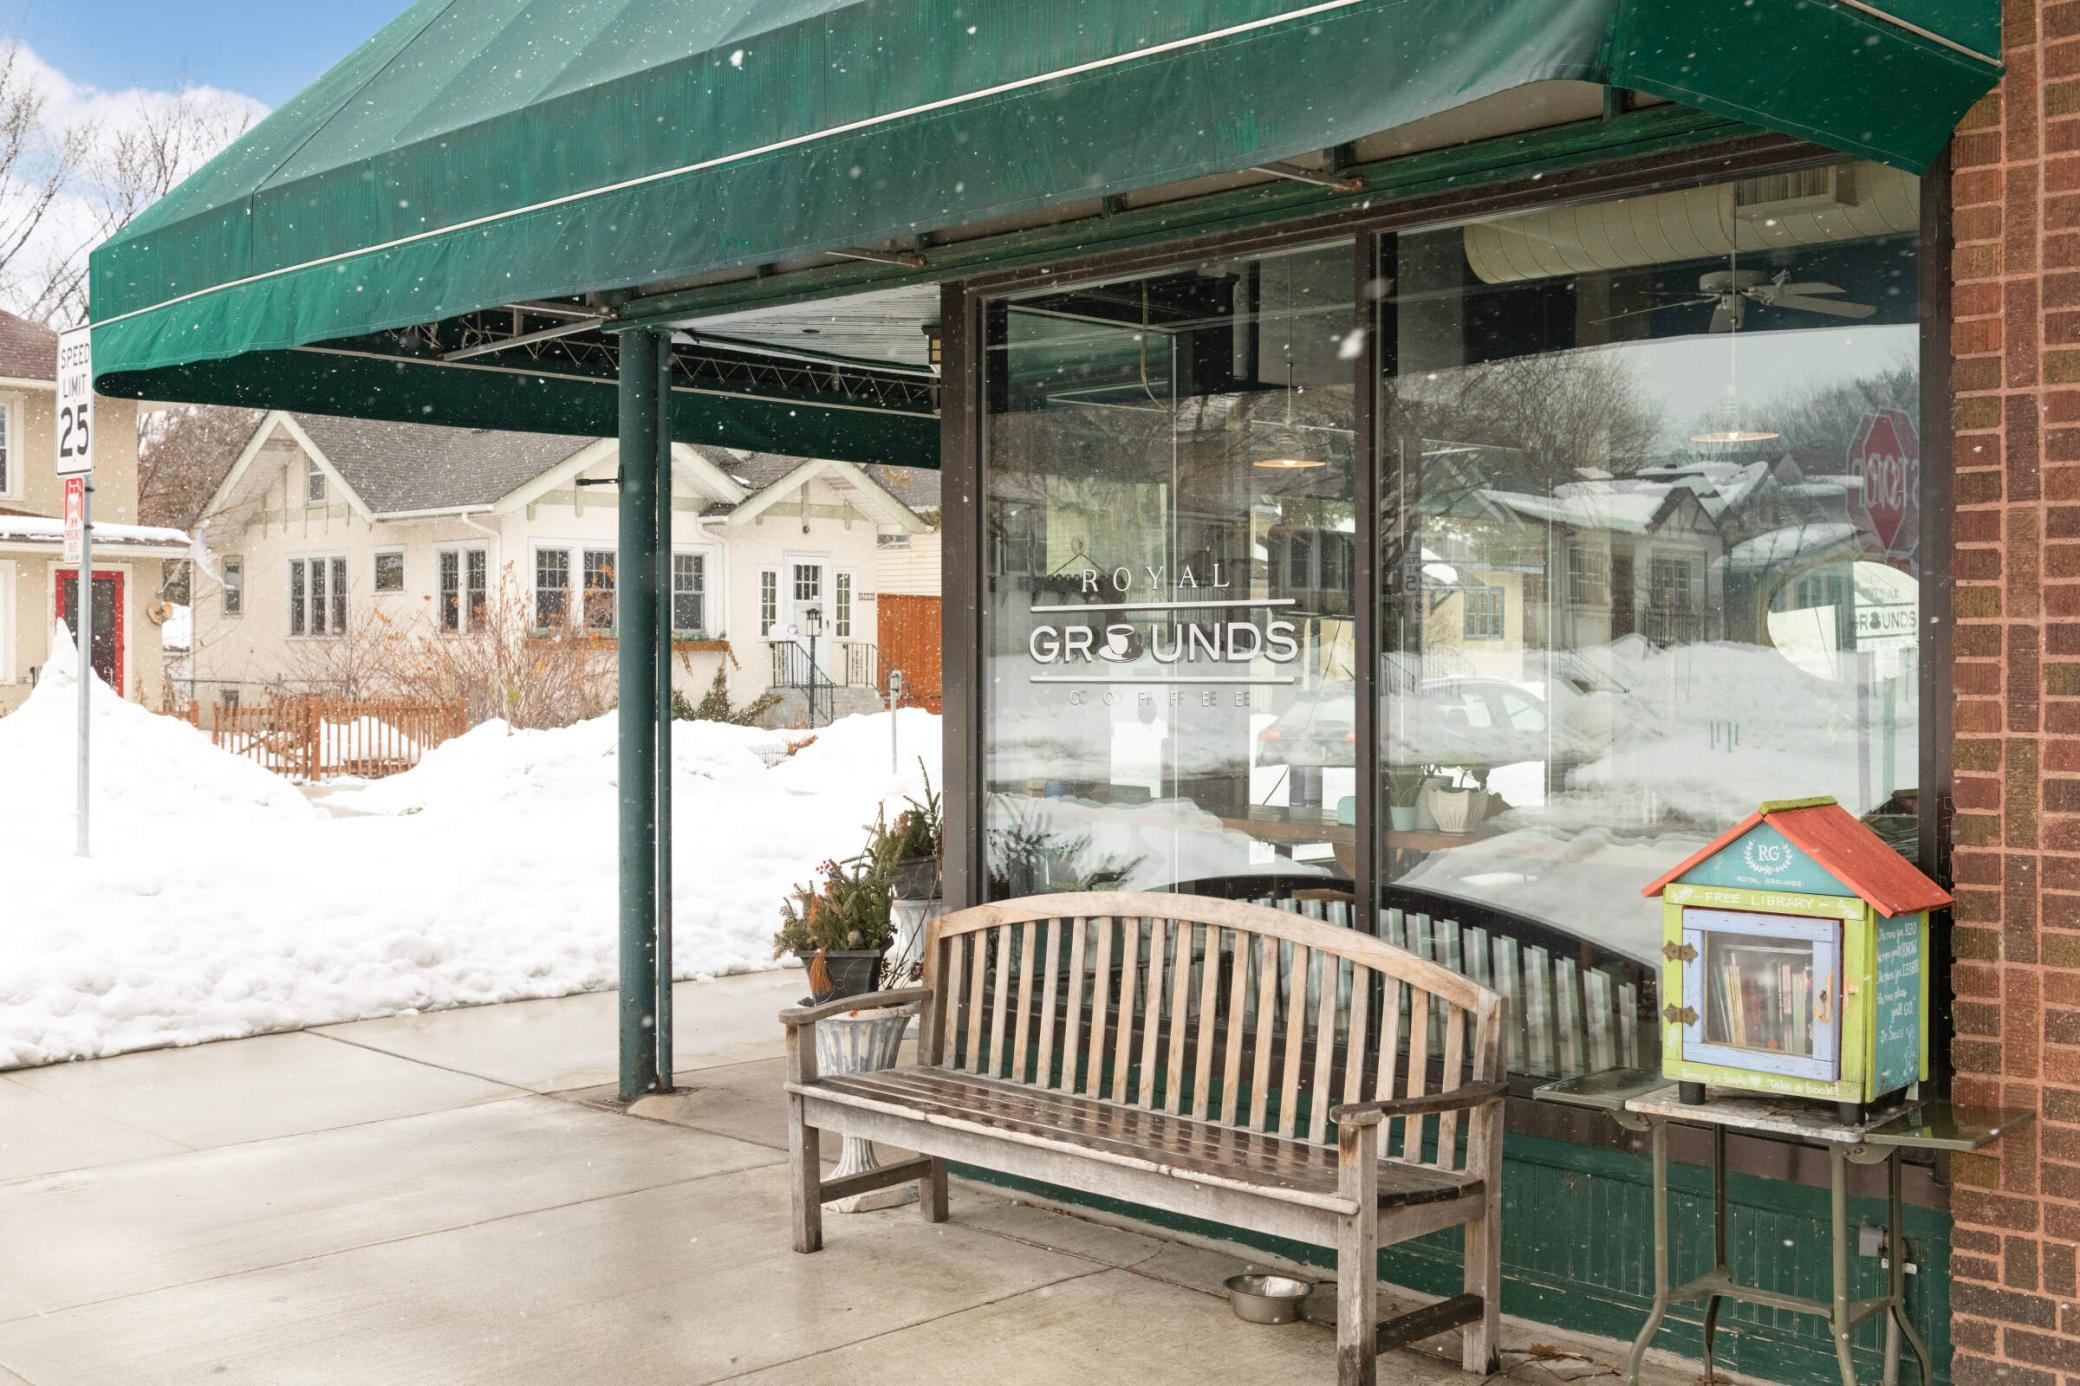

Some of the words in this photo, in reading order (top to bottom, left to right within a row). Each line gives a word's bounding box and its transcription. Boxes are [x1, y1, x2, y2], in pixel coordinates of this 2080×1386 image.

[61, 342, 89, 370] SPEED
[63, 374, 87, 398] LIMIT
[60, 403, 88, 458] 25
[1082, 563, 1230, 593] ROYAL
[1070, 690, 1247, 707] COFFEE
[1758, 845, 1780, 861] RG
[1706, 892, 1740, 904] FREE
[1751, 895, 1814, 909] LIBRARY
